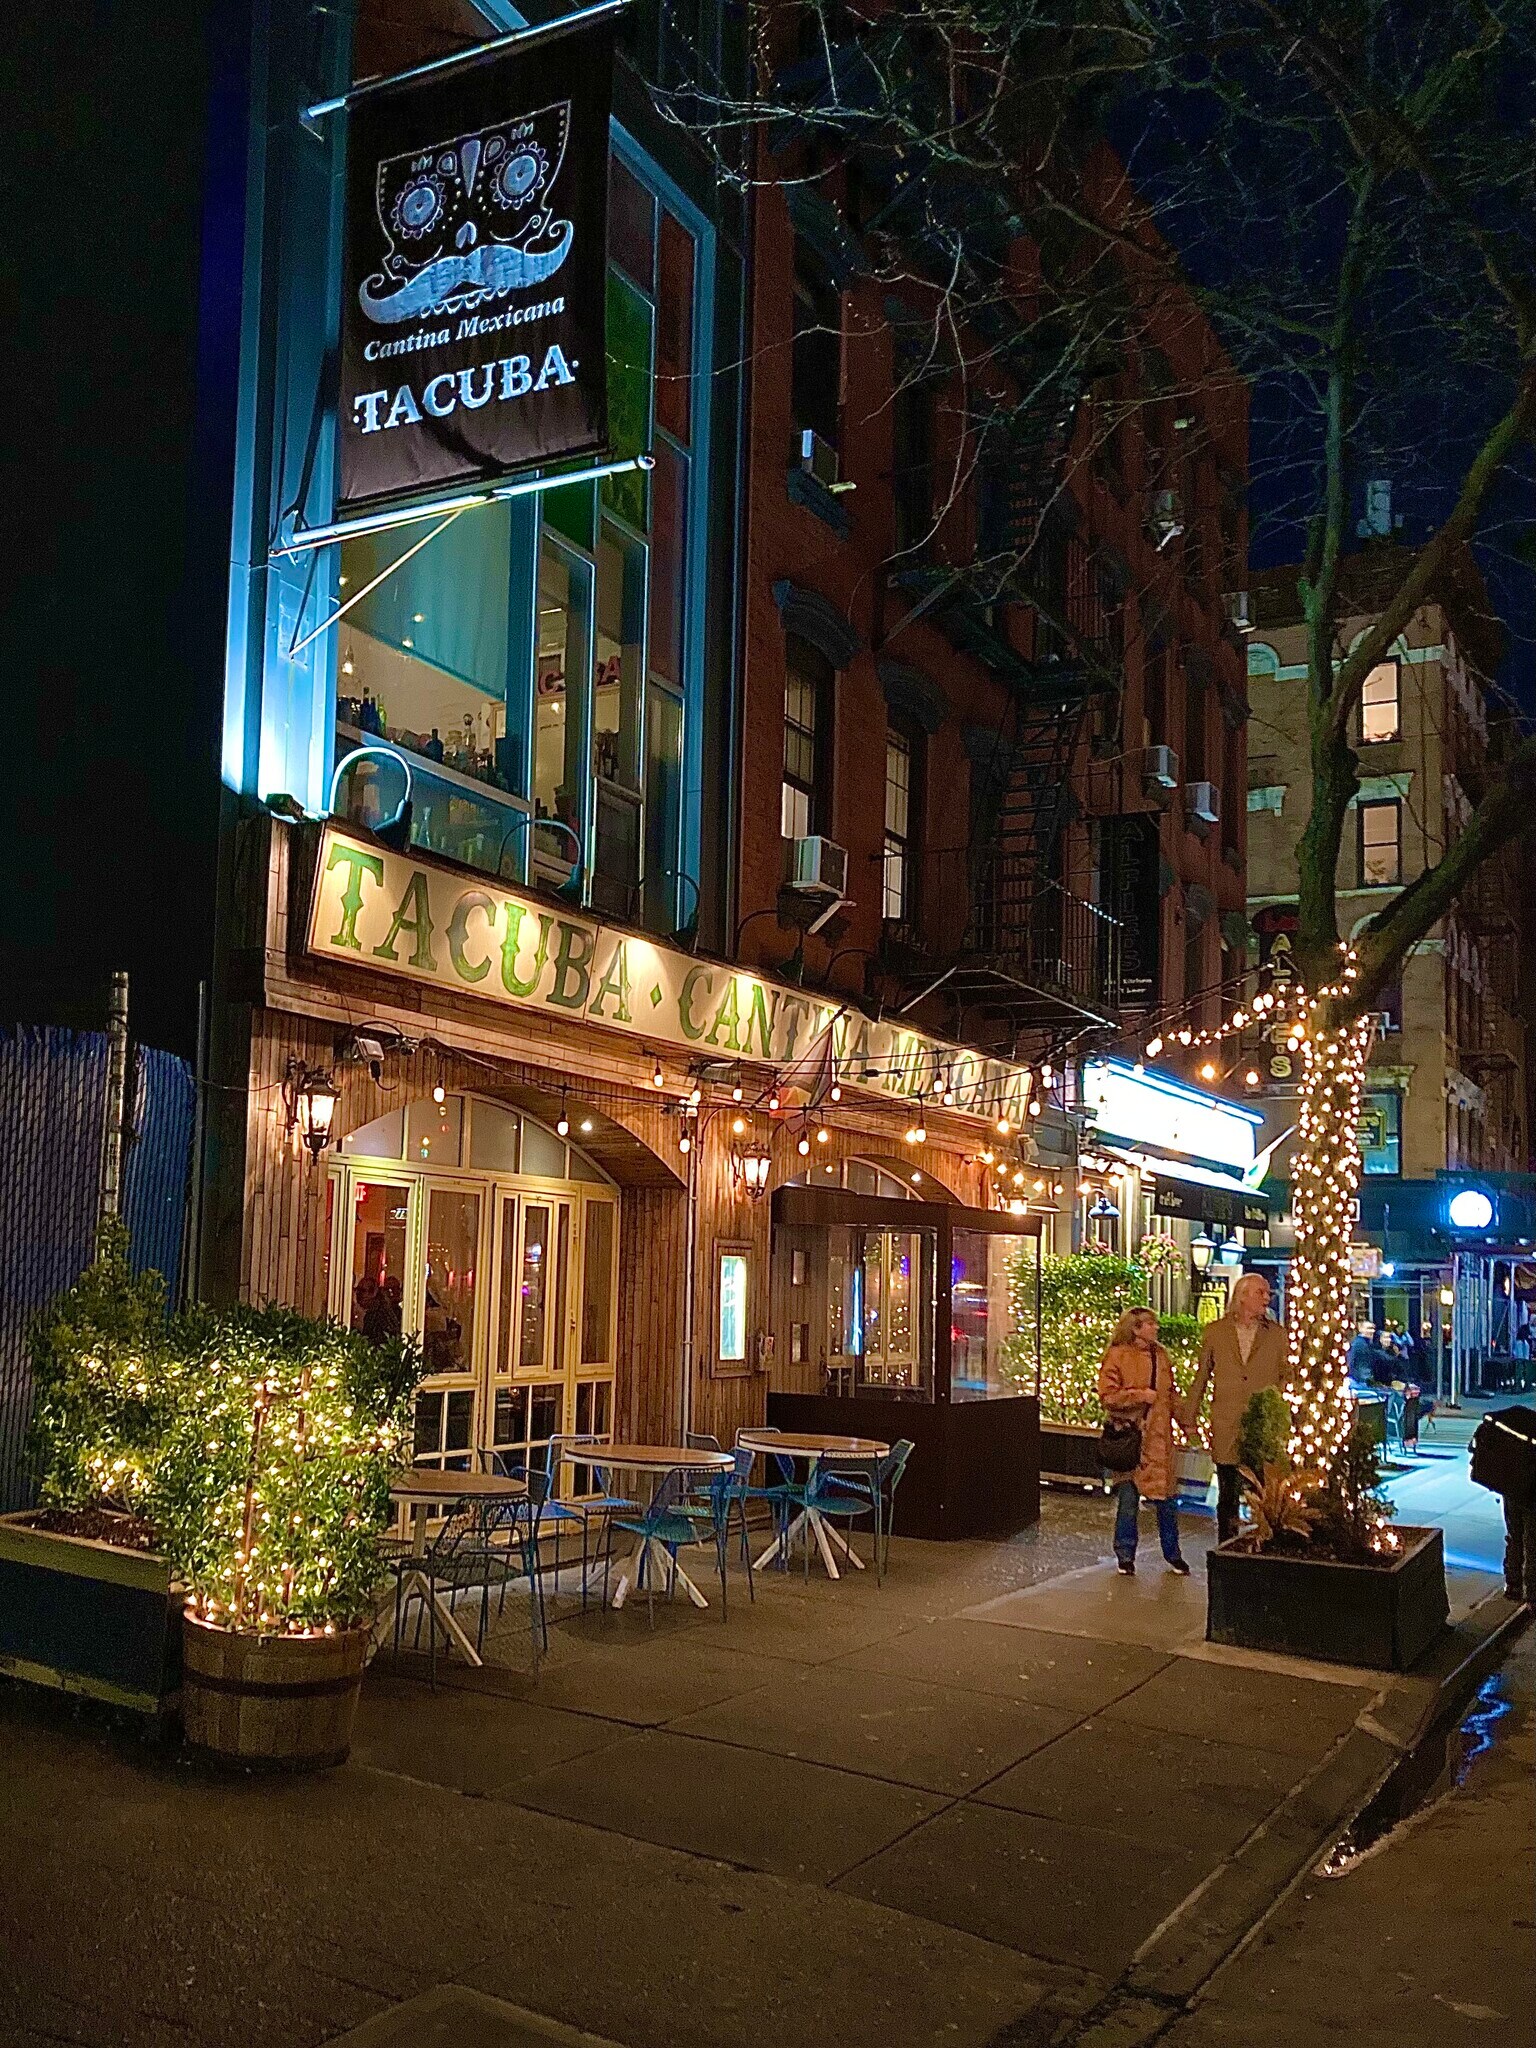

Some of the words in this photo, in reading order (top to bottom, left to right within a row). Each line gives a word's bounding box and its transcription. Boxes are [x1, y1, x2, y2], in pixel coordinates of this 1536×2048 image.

[364, 326, 450, 361] Cantina
[457, 295, 566, 341] Mexicana
[355, 344, 576, 434] TACUBA
[327, 842, 633, 1023] TACUBA
[677, 966, 871, 1085] CANTINA
[881, 1029, 1022, 1125] MEXICANA
